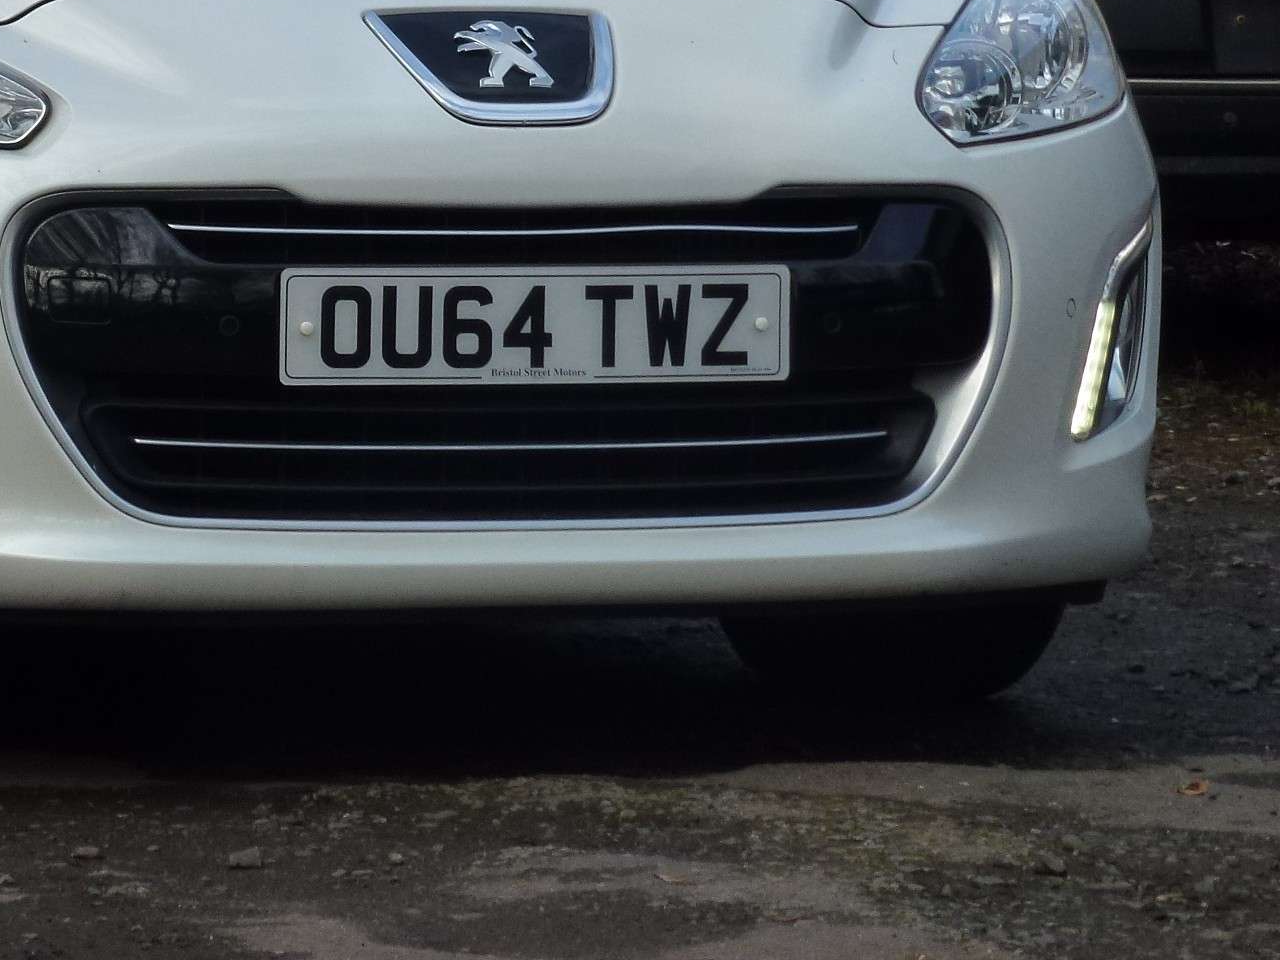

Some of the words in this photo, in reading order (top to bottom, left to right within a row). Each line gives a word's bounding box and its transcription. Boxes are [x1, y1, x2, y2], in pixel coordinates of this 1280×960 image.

[320, 284, 553, 369] OU64
[585, 283, 750, 368] TWZ
[490, 367, 521, 378] Bristol
[523, 367, 552, 377] Street
[554, 366, 587, 377] Motors
